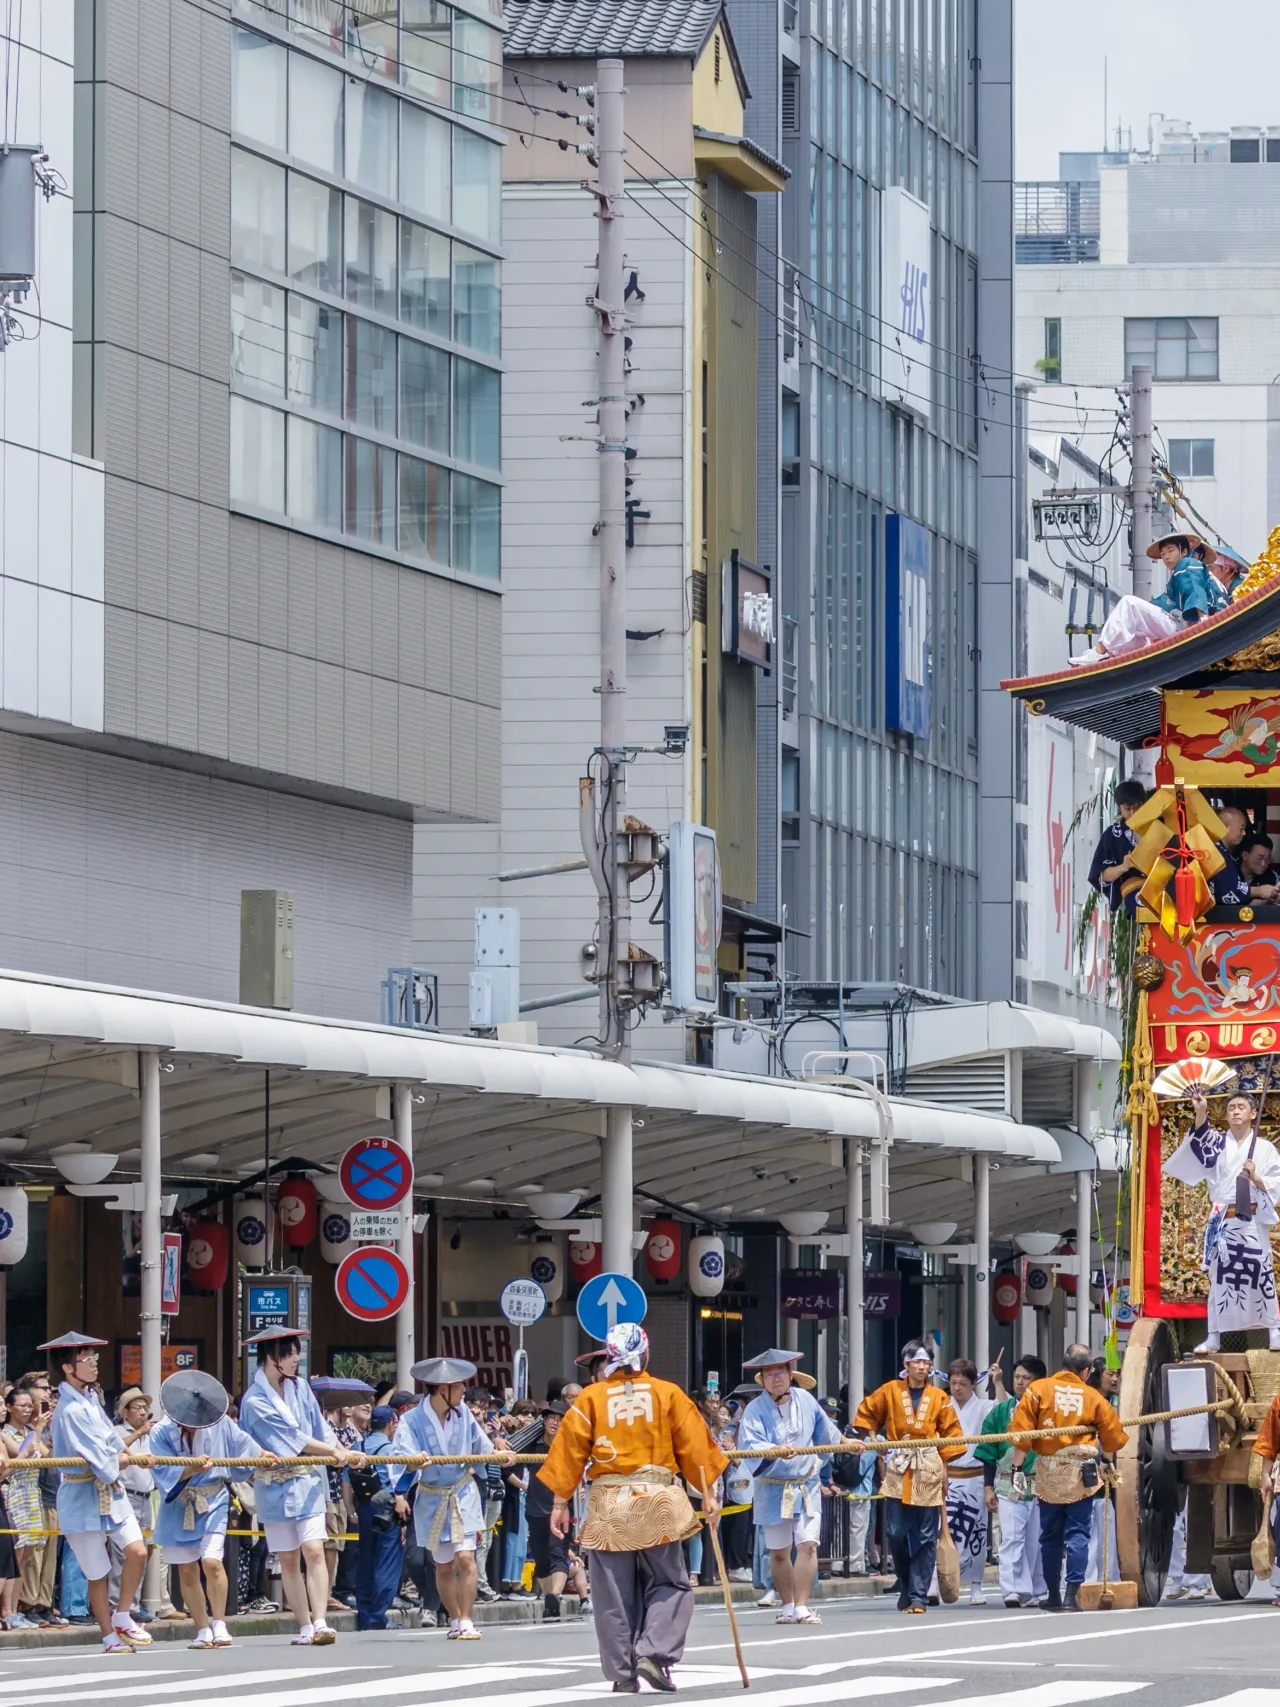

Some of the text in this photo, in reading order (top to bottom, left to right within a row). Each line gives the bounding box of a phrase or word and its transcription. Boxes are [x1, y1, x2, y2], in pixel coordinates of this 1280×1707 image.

[901, 260, 927, 345] HIS
[353, 1215, 399, 1225] 人の乗降のため
[353, 1227, 392, 1237] の停車を除く
[1216, 1243, 1263, 1291] 南
[258, 1297, 281, 1305] 市バス
[255, 1317, 264, 1328] F
[176, 1355, 194, 1366] 8F
[607, 1381, 654, 1428] 南
[1054, 1385, 1084, 1417] 南
